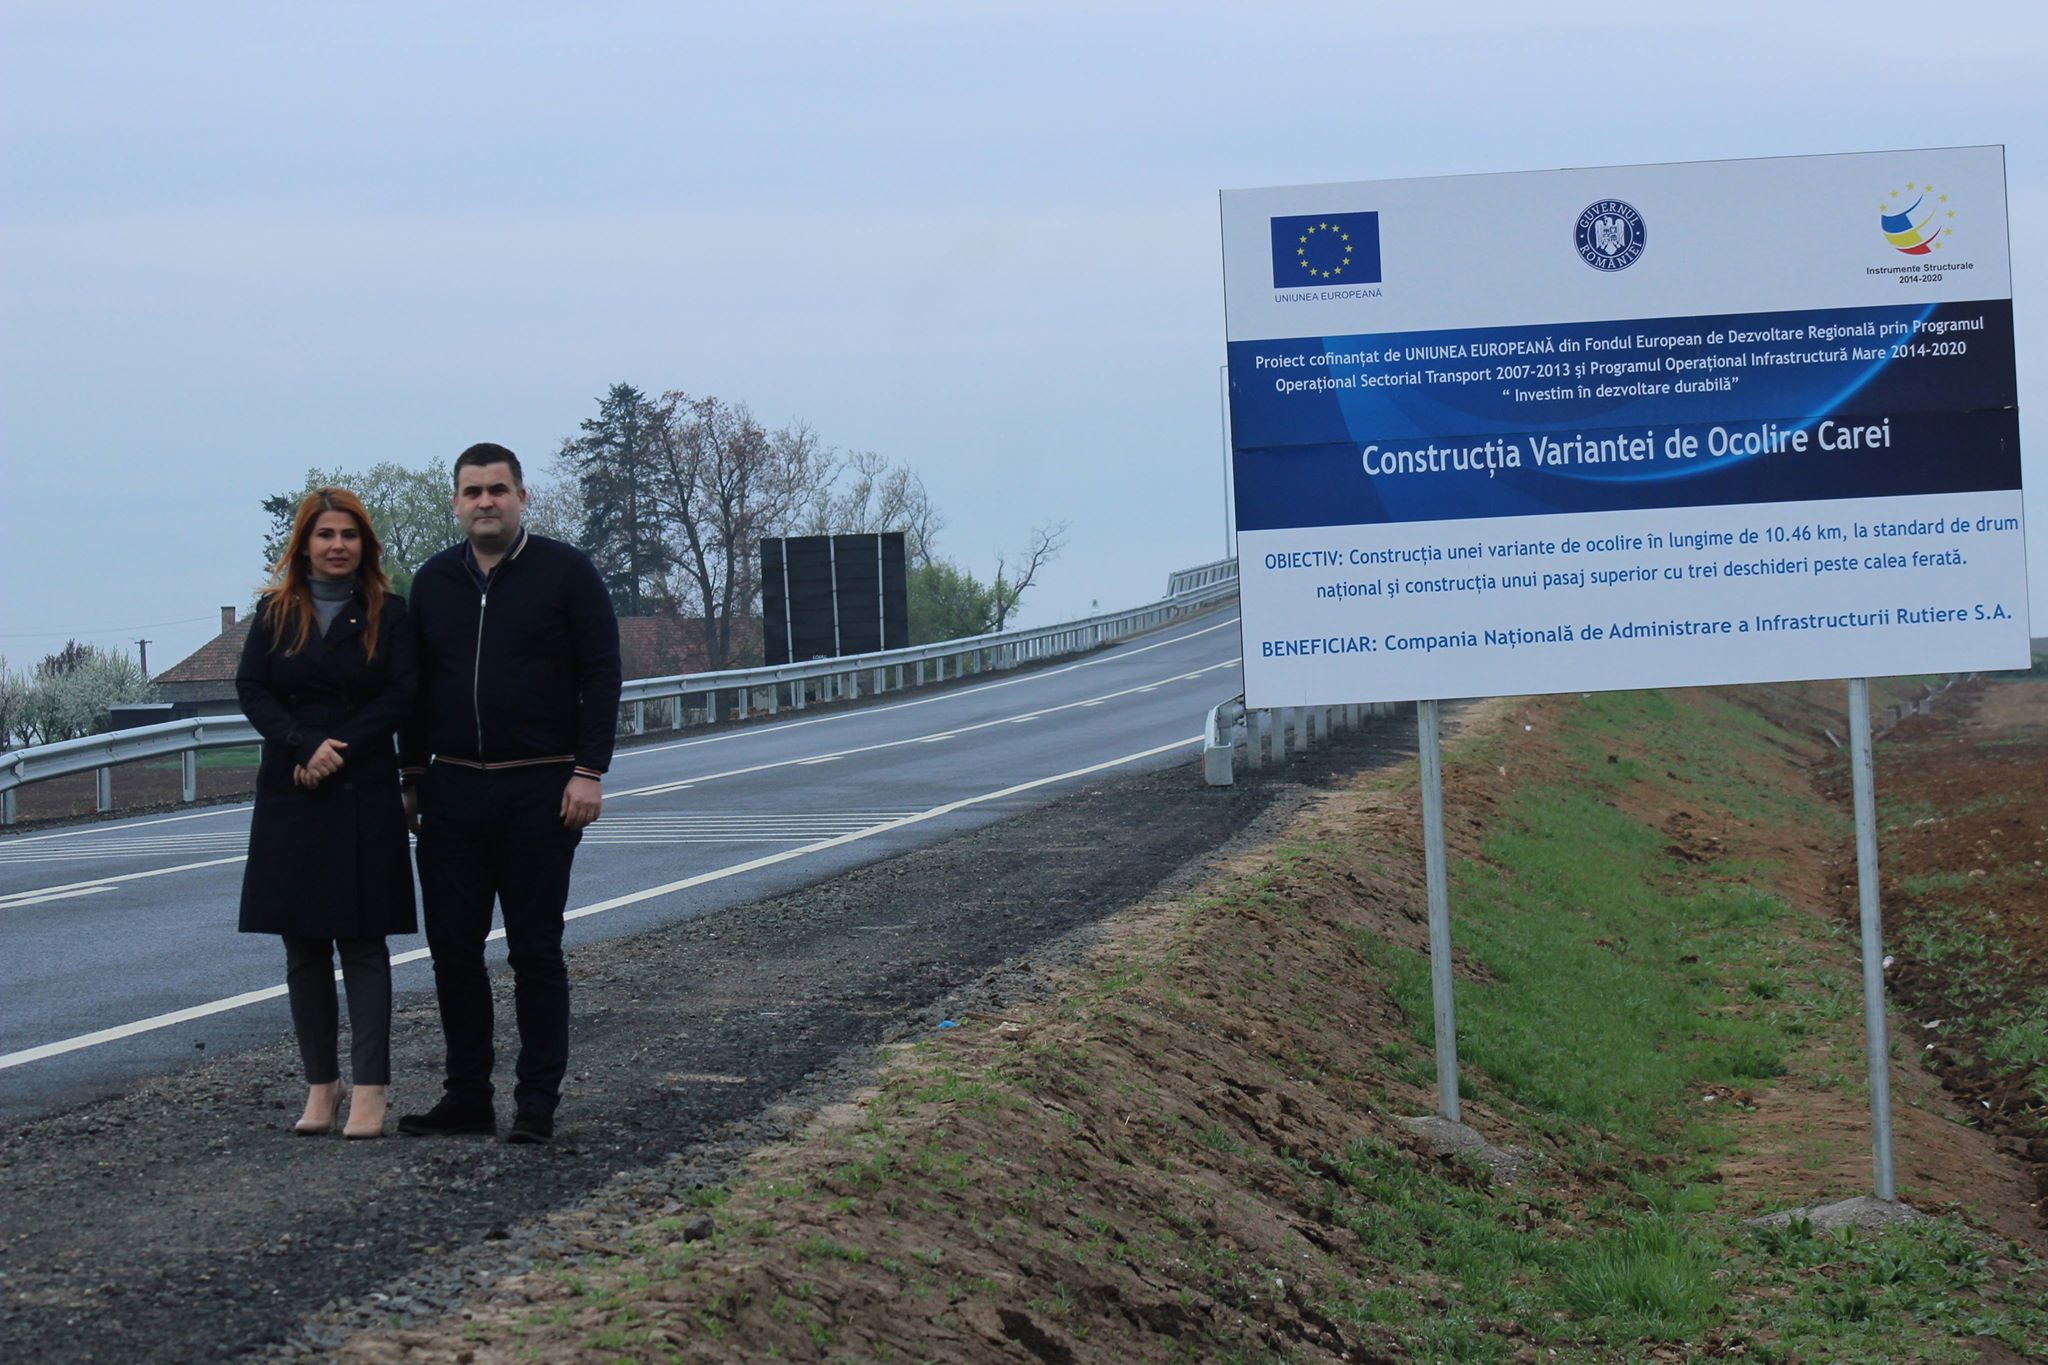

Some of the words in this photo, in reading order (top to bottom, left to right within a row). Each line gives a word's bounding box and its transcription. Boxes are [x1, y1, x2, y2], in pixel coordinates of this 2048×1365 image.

[1580, 202, 1639, 228] GUVERNUL
[1867, 266, 1920, 274] Instrumente
[1924, 262, 1973, 271] Structurale
[1899, 274, 1942, 283] 2014-2020
[1275, 293, 1319, 302] UNIUNEA
[1321, 288, 1382, 300] EUROPEANĂ
[1256, 355, 1305, 368] Proiect
[1310, 351, 1379, 369] cofinanțat
[1384, 349, 1400, 361] de
[1406, 345, 1467, 360] UNIUNEA
[1471, 337, 1554, 357] EUROPEANĂ
[1559, 339, 1580, 352] din
[1585, 336, 1631, 350] Fondul
[1637, 334, 1701, 350] European
[1707, 331, 1723, 344] de
[1729, 328, 1803, 343] Dezvoltare
[1808, 322, 1875, 341] Regională
[1880, 321, 1908, 338] prin
[1913, 316, 1983, 334] Programul
[1276, 375, 1356, 394] Operațional
[1361, 371, 1421, 387] Sectorial
[1425, 369, 1491, 387] Transport
[1497, 363, 1570, 379] 2007-2013
[1591, 358, 1660, 376] Programul
[1666, 353, 1746, 373] Operațional
[1752, 348, 1847, 366] Infrastructură
[1852, 348, 1886, 360] Mare
[1891, 342, 1966, 358] 2014-2020
[1516, 387, 1573, 401] Investim
[1578, 385, 1591, 398] în
[1596, 382, 1670, 397] dezvoltare
[1363, 439, 1521, 478] Construcția
[1529, 431, 1653, 466] Variantei
[1665, 428, 1698, 458] de
[1708, 424, 1808, 456] Ocolire
[1818, 418, 1890, 450] Carei
[1265, 551, 1342, 569] OBIECTIV:
[1350, 546, 1441, 565] Construcția
[1448, 543, 1482, 559] unei
[1488, 541, 1555, 557] variante
[1561, 538, 1580, 553] de
[1587, 535, 1642, 552] ocolire
[1648, 533, 1662, 548] în
[1670, 531, 1733, 550] lungime
[1739, 528, 1758, 544] de
[1766, 526, 1811, 542] 10.46
[1818, 525, 1846, 541] km,
[1854, 523, 1867, 538] la
[1874, 518, 1944, 537] standard
[1951, 518, 1970, 533] de
[1976, 516, 2018, 531] drum
[1317, 580, 1381, 601] național
[1406, 574, 1496, 594] construcția
[1502, 572, 1536, 588] unui
[1543, 569, 1584, 590] pasaj
[1591, 566, 1658, 586] superior
[1664, 568, 1682, 579] cu
[1688, 562, 1717, 578] trei
[1724, 557, 1807, 576] deschideri
[1814, 557, 1858, 576] peste
[1864, 553, 1906, 569] calea
[1912, 549, 1966, 566] ferată.
[1263, 637, 1376, 657] BENEFICIAR:
[1385, 632, 1477, 652] Compania
[1485, 625, 1573, 648] Națională
[1581, 625, 1603, 640] de
[1609, 621, 1731, 639] Administrare
[1739, 621, 1748, 632] a
[1757, 610, 1889, 631] Infrastructurii
[1897, 607, 1967, 624] Rutiere
[1975, 604, 2011, 620] S.A.
